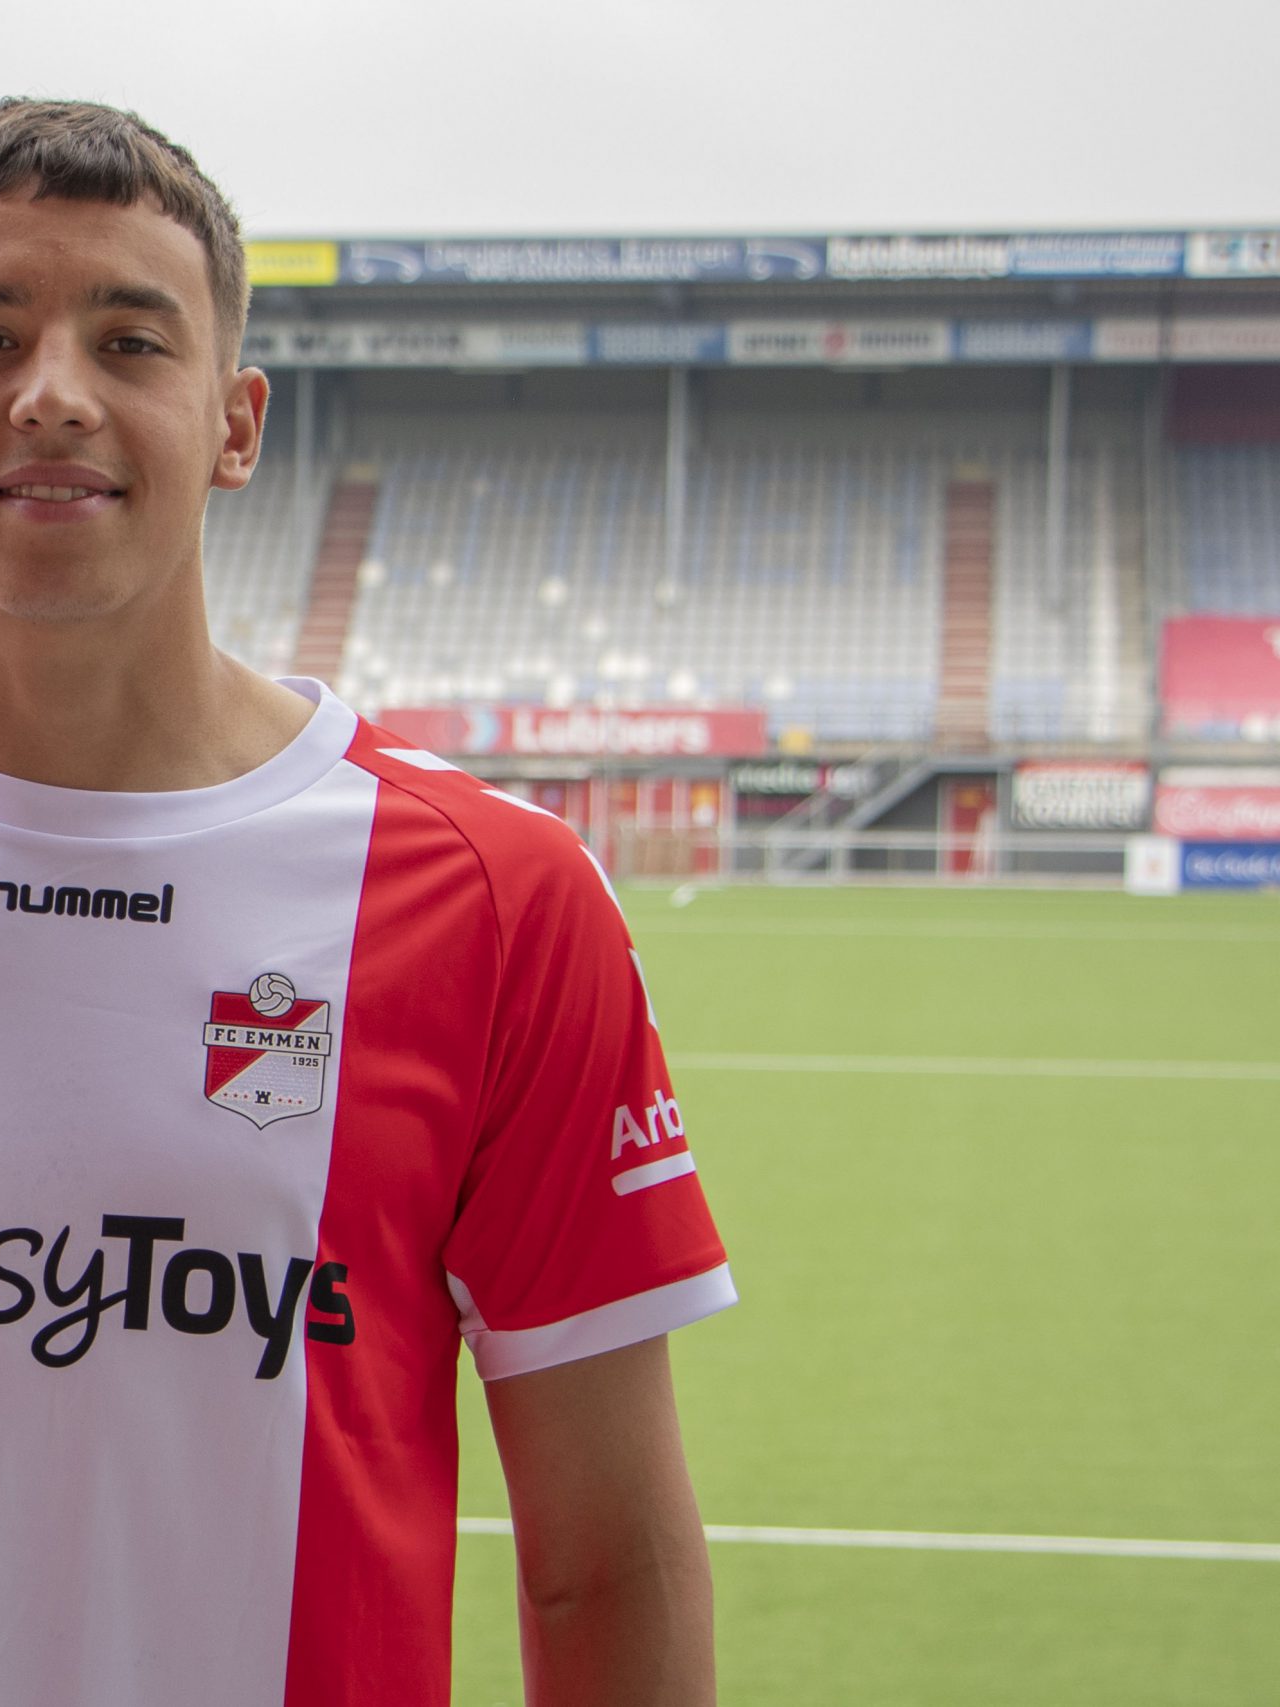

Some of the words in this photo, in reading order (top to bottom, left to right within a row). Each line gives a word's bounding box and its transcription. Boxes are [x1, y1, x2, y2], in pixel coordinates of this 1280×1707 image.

[512, 708, 709, 755] Lubbers
[214, 1028, 236, 1042] FC
[245, 1031, 320, 1050] EMMEN
[292, 1056, 319, 1067] 1925
